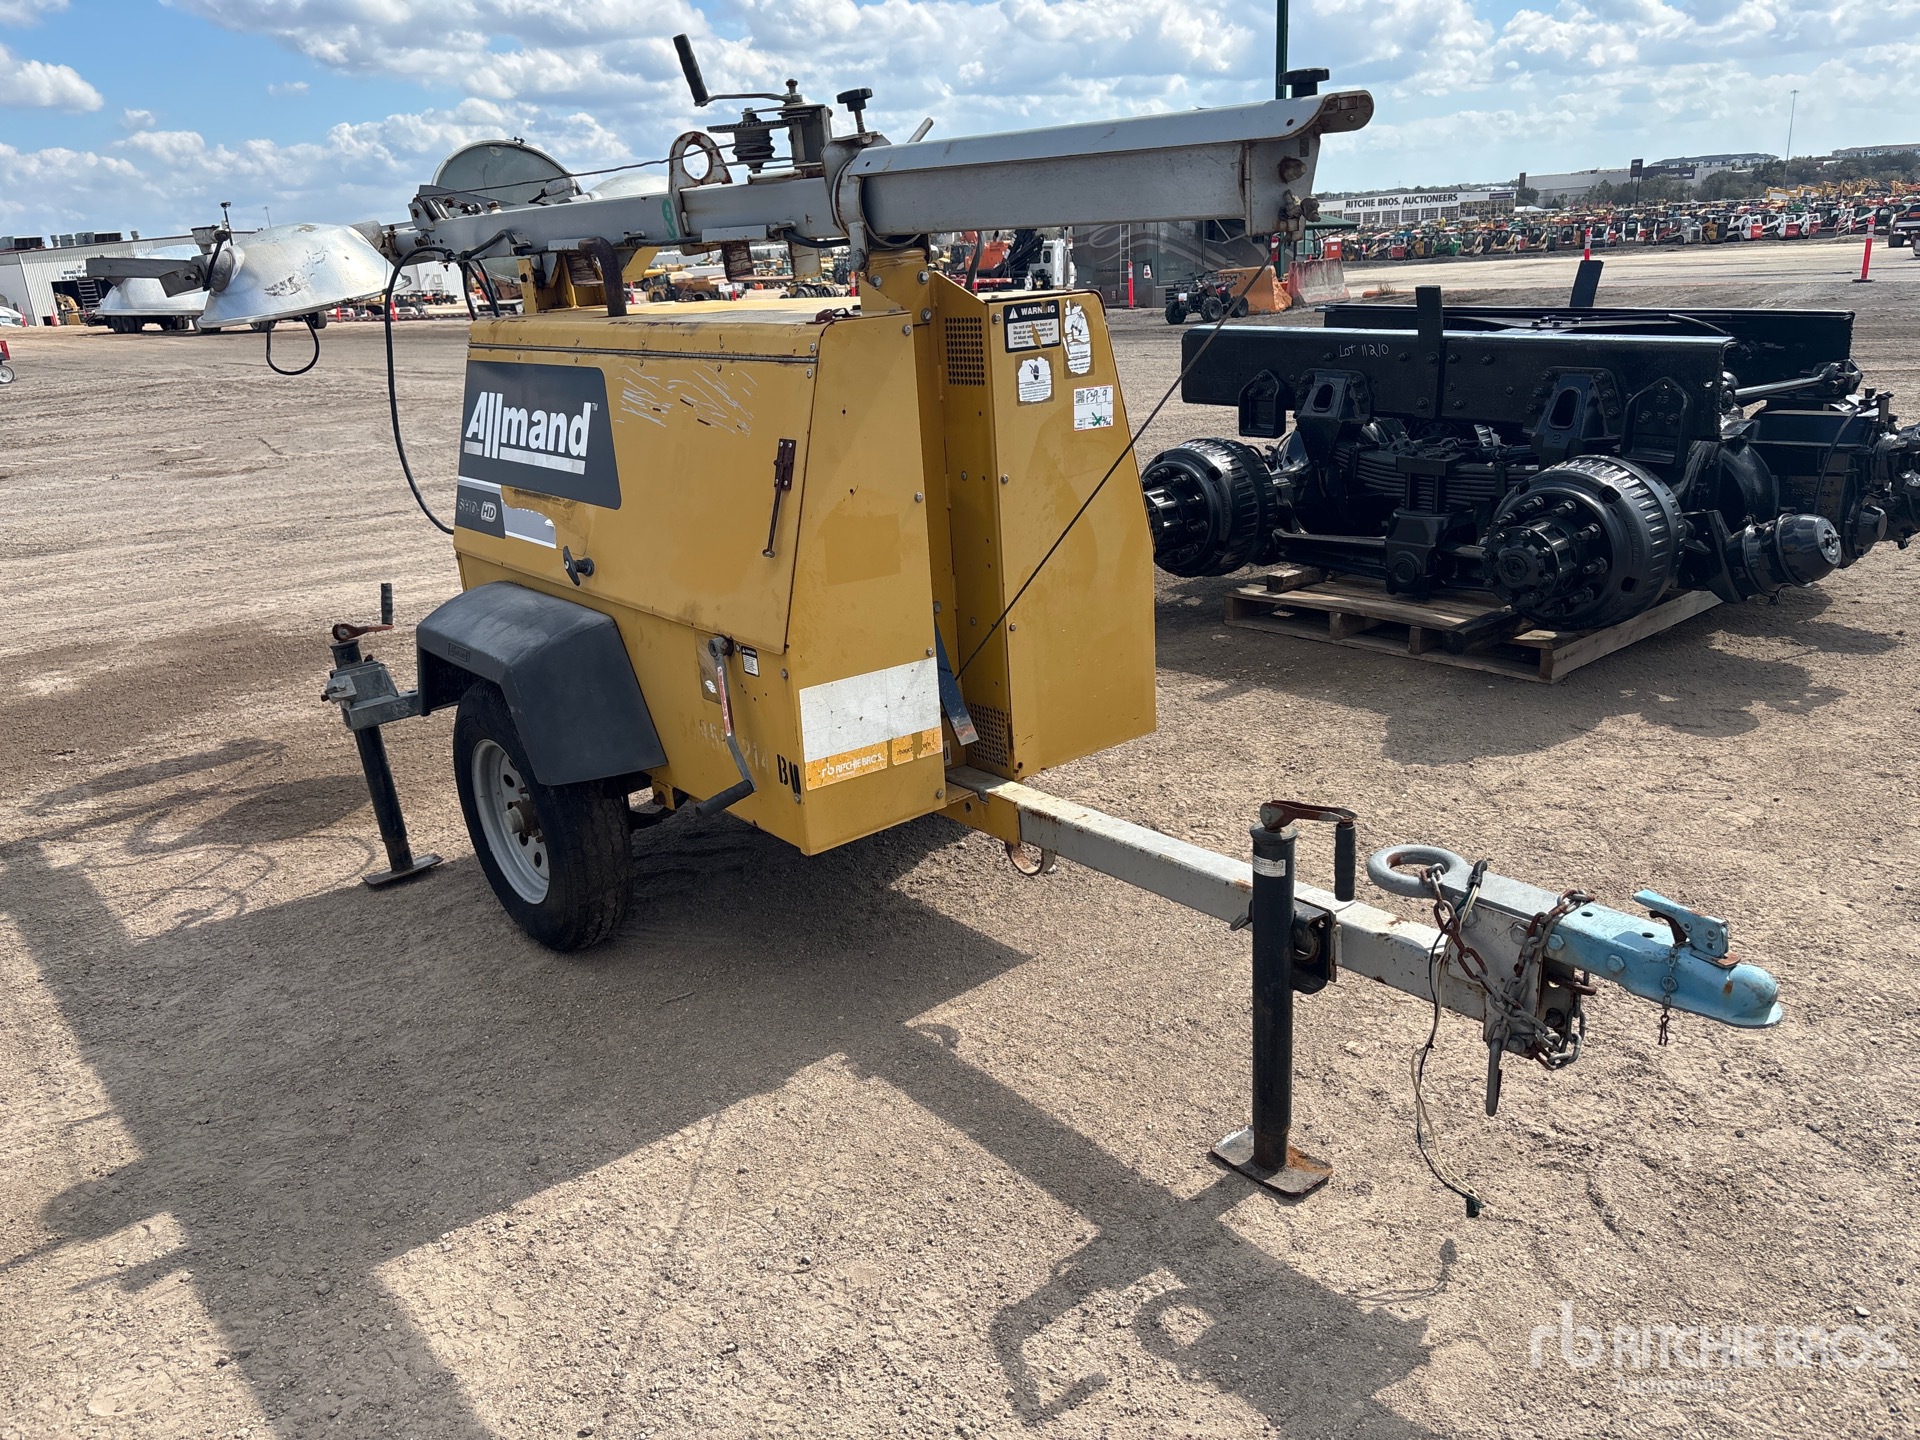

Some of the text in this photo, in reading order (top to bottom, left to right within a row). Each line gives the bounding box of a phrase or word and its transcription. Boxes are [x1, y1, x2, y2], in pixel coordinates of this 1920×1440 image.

[1345, 193, 1458, 209] RITCHIE BROS. AUCTIONEERS
[1020, 304, 1056, 316] WARNG
[1339, 343, 1389, 358] Lot 11210
[465, 392, 592, 459] Allmand
[835, 758, 861, 774] RITCHIE
